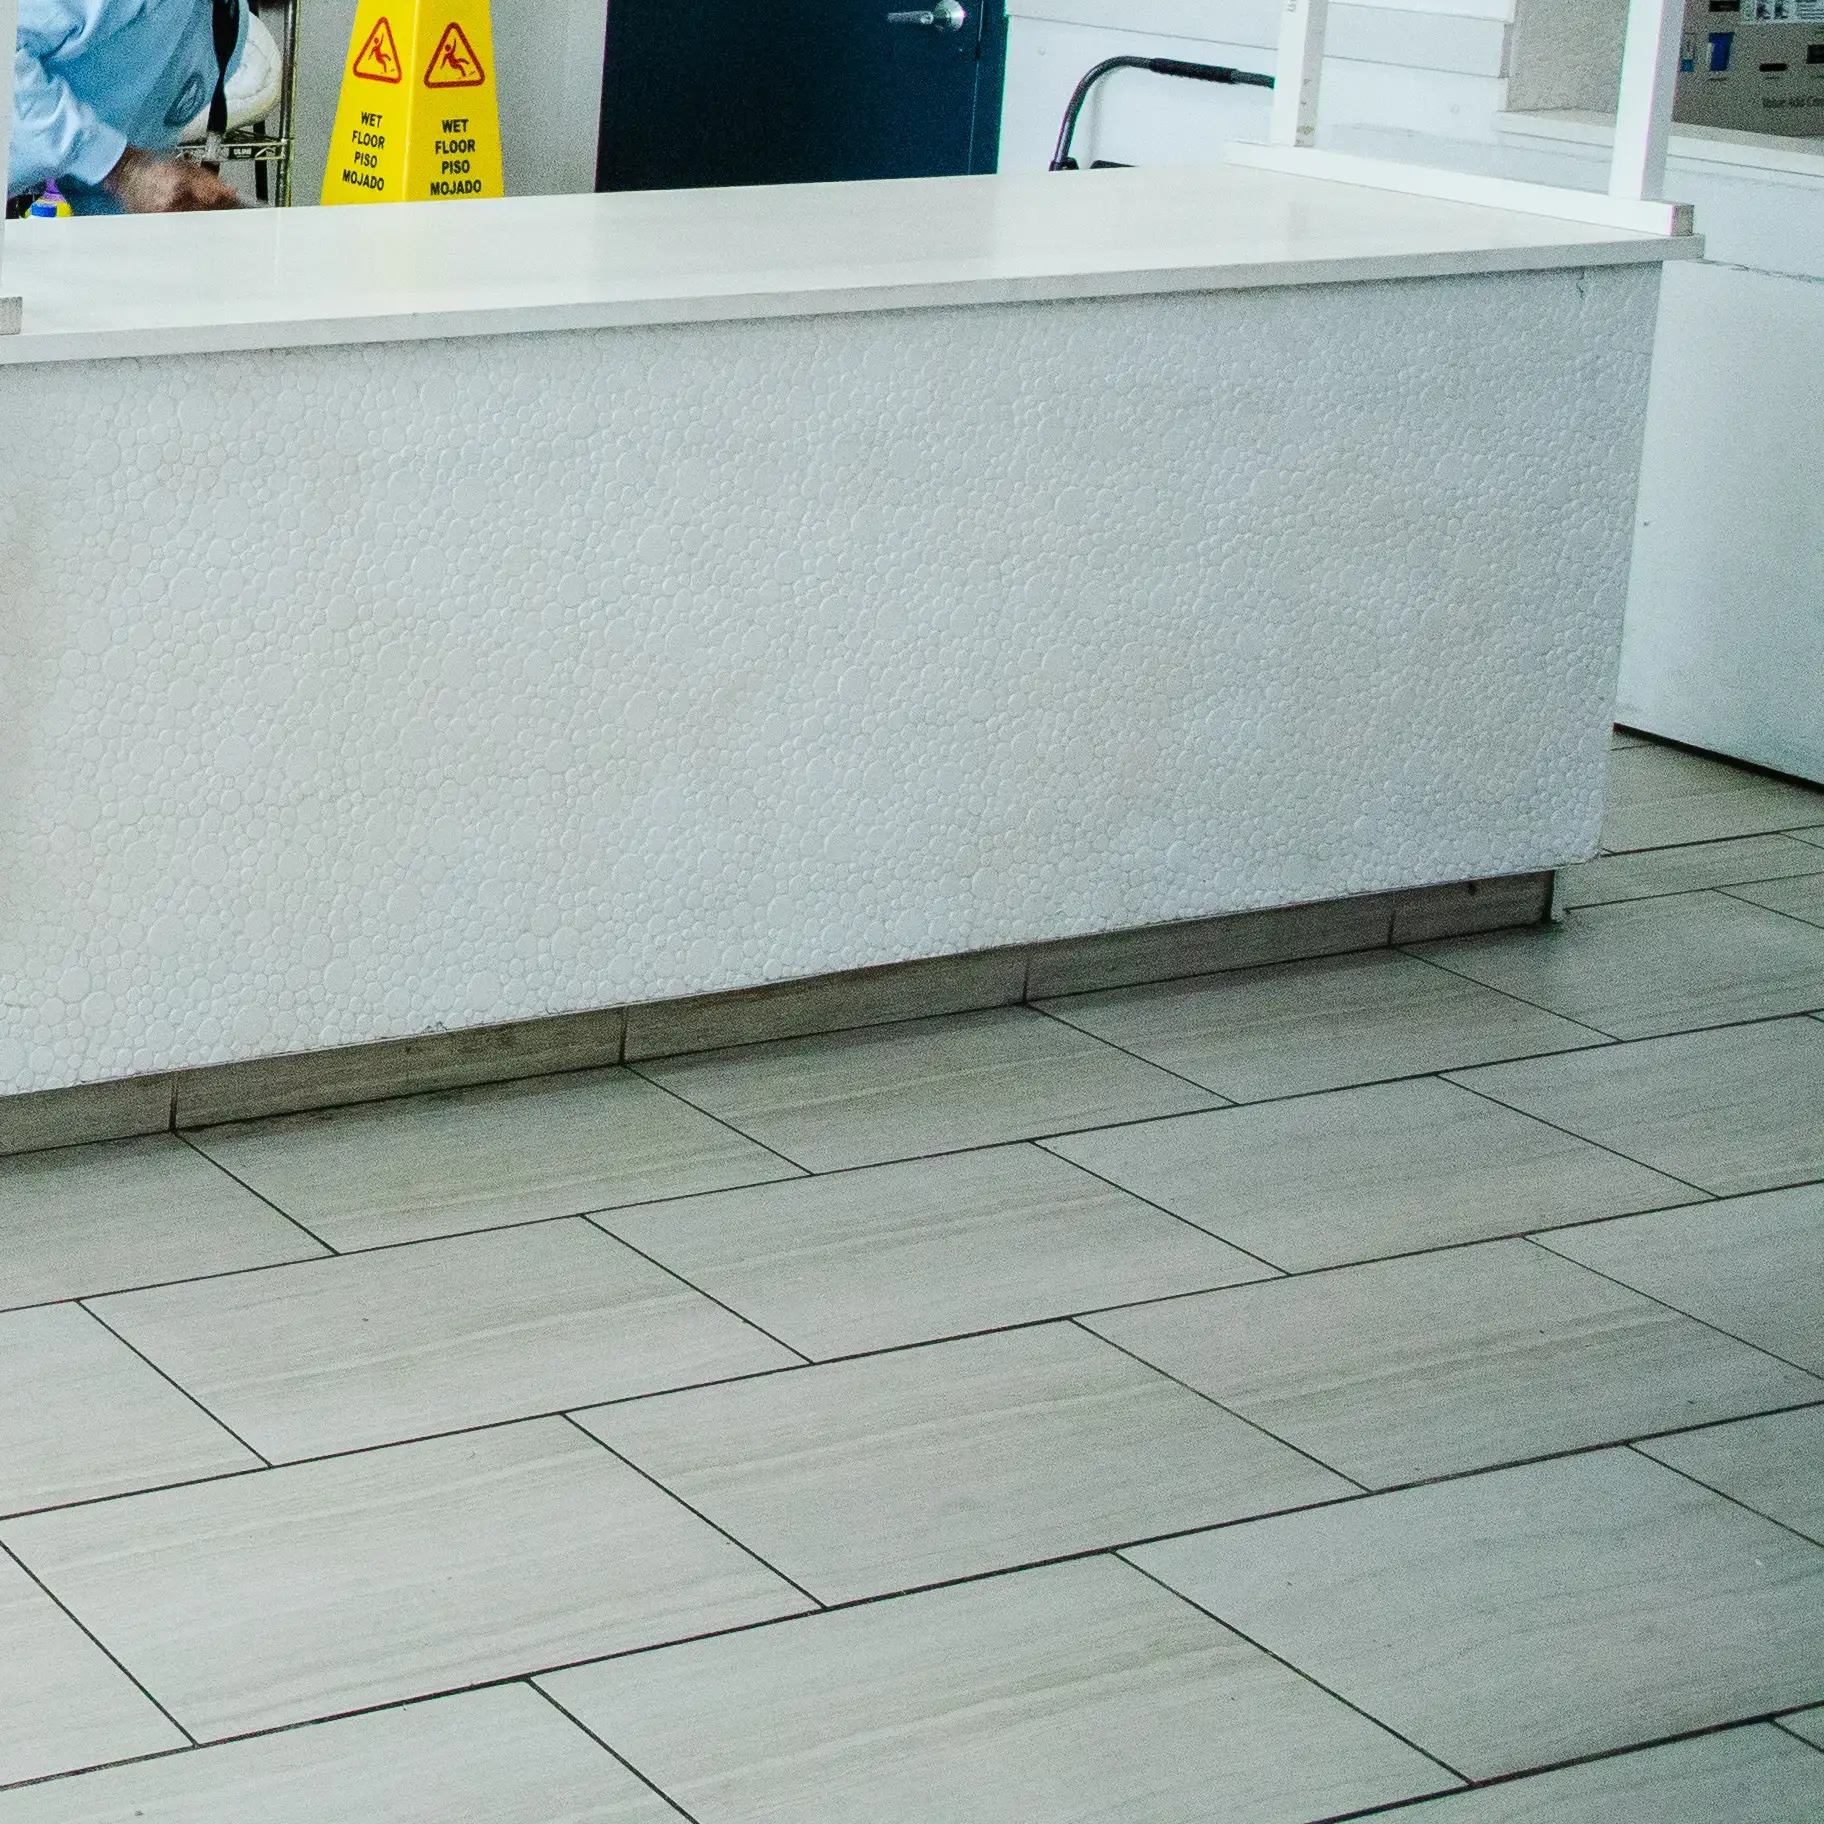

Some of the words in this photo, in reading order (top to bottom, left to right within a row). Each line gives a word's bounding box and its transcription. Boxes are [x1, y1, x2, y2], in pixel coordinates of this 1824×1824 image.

[361, 111, 381, 128] WET
[442, 119, 468, 134] WET
[352, 130, 385, 149] FLOOR
[435, 140, 475, 154] FLOOR
[354, 150, 378, 168] PISO
[441, 160, 470, 174] PISO
[342, 168, 384, 191] MOJADO
[430, 180, 482, 196] MOJADO
